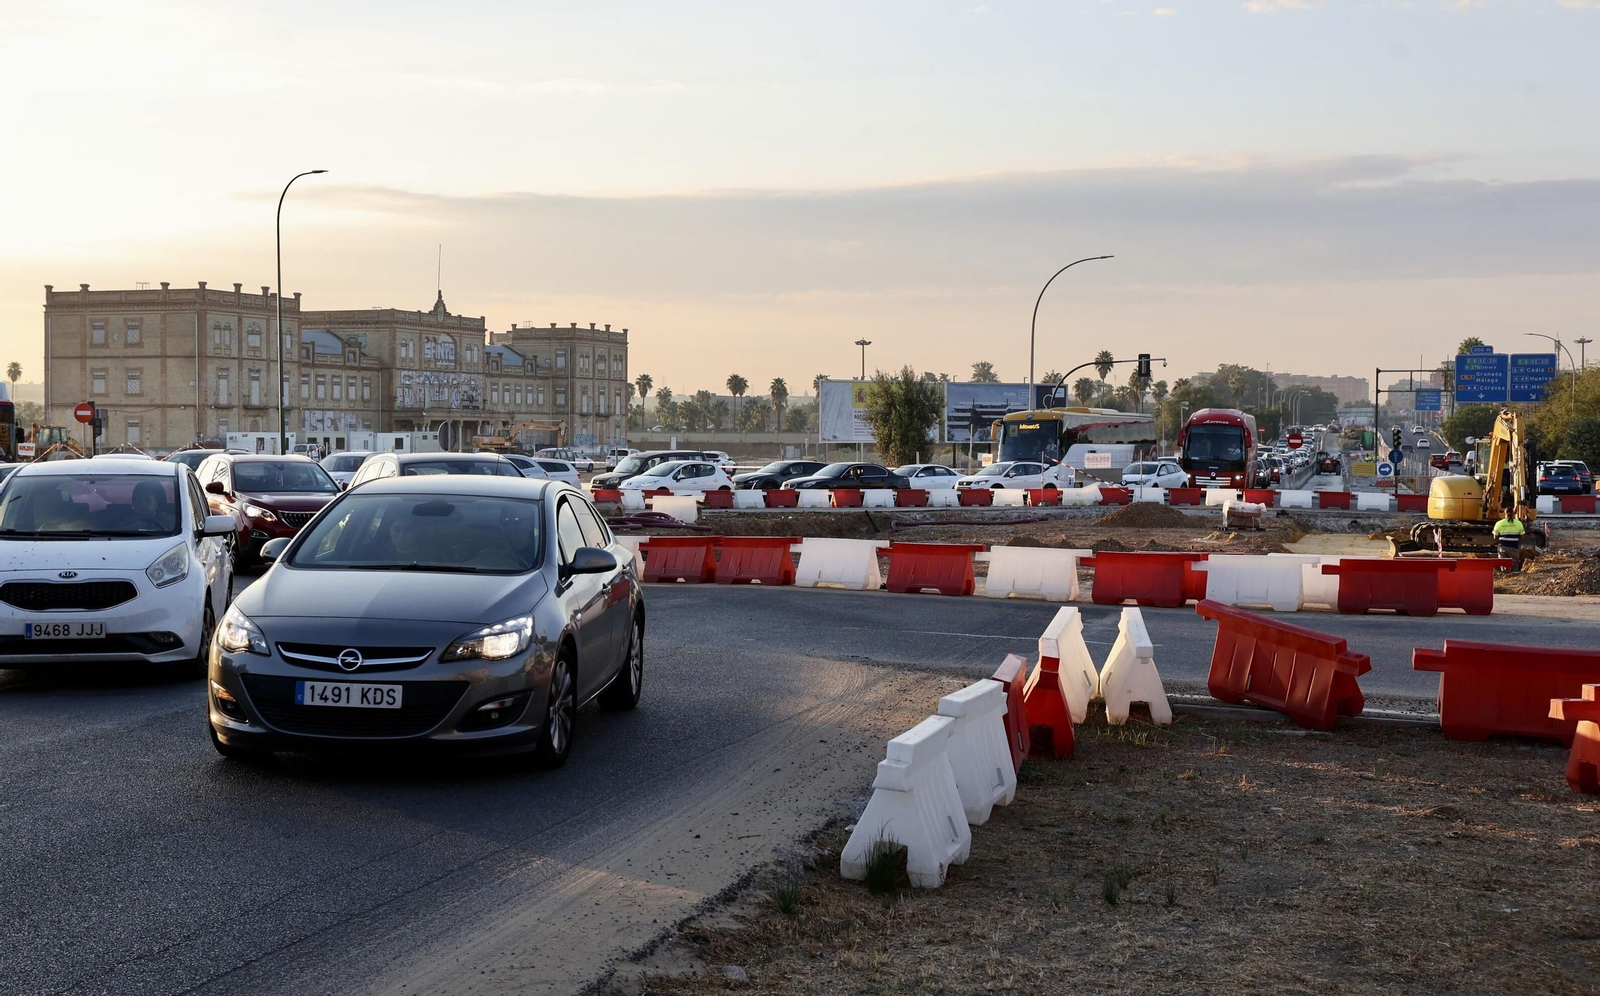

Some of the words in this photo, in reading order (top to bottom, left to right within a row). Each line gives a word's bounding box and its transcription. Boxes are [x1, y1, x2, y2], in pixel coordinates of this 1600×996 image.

[34, 624, 70, 637] 9468
[76, 623, 103, 636] JJJ
[309, 684, 351, 704] 1491
[360, 687, 397, 706] KDS
